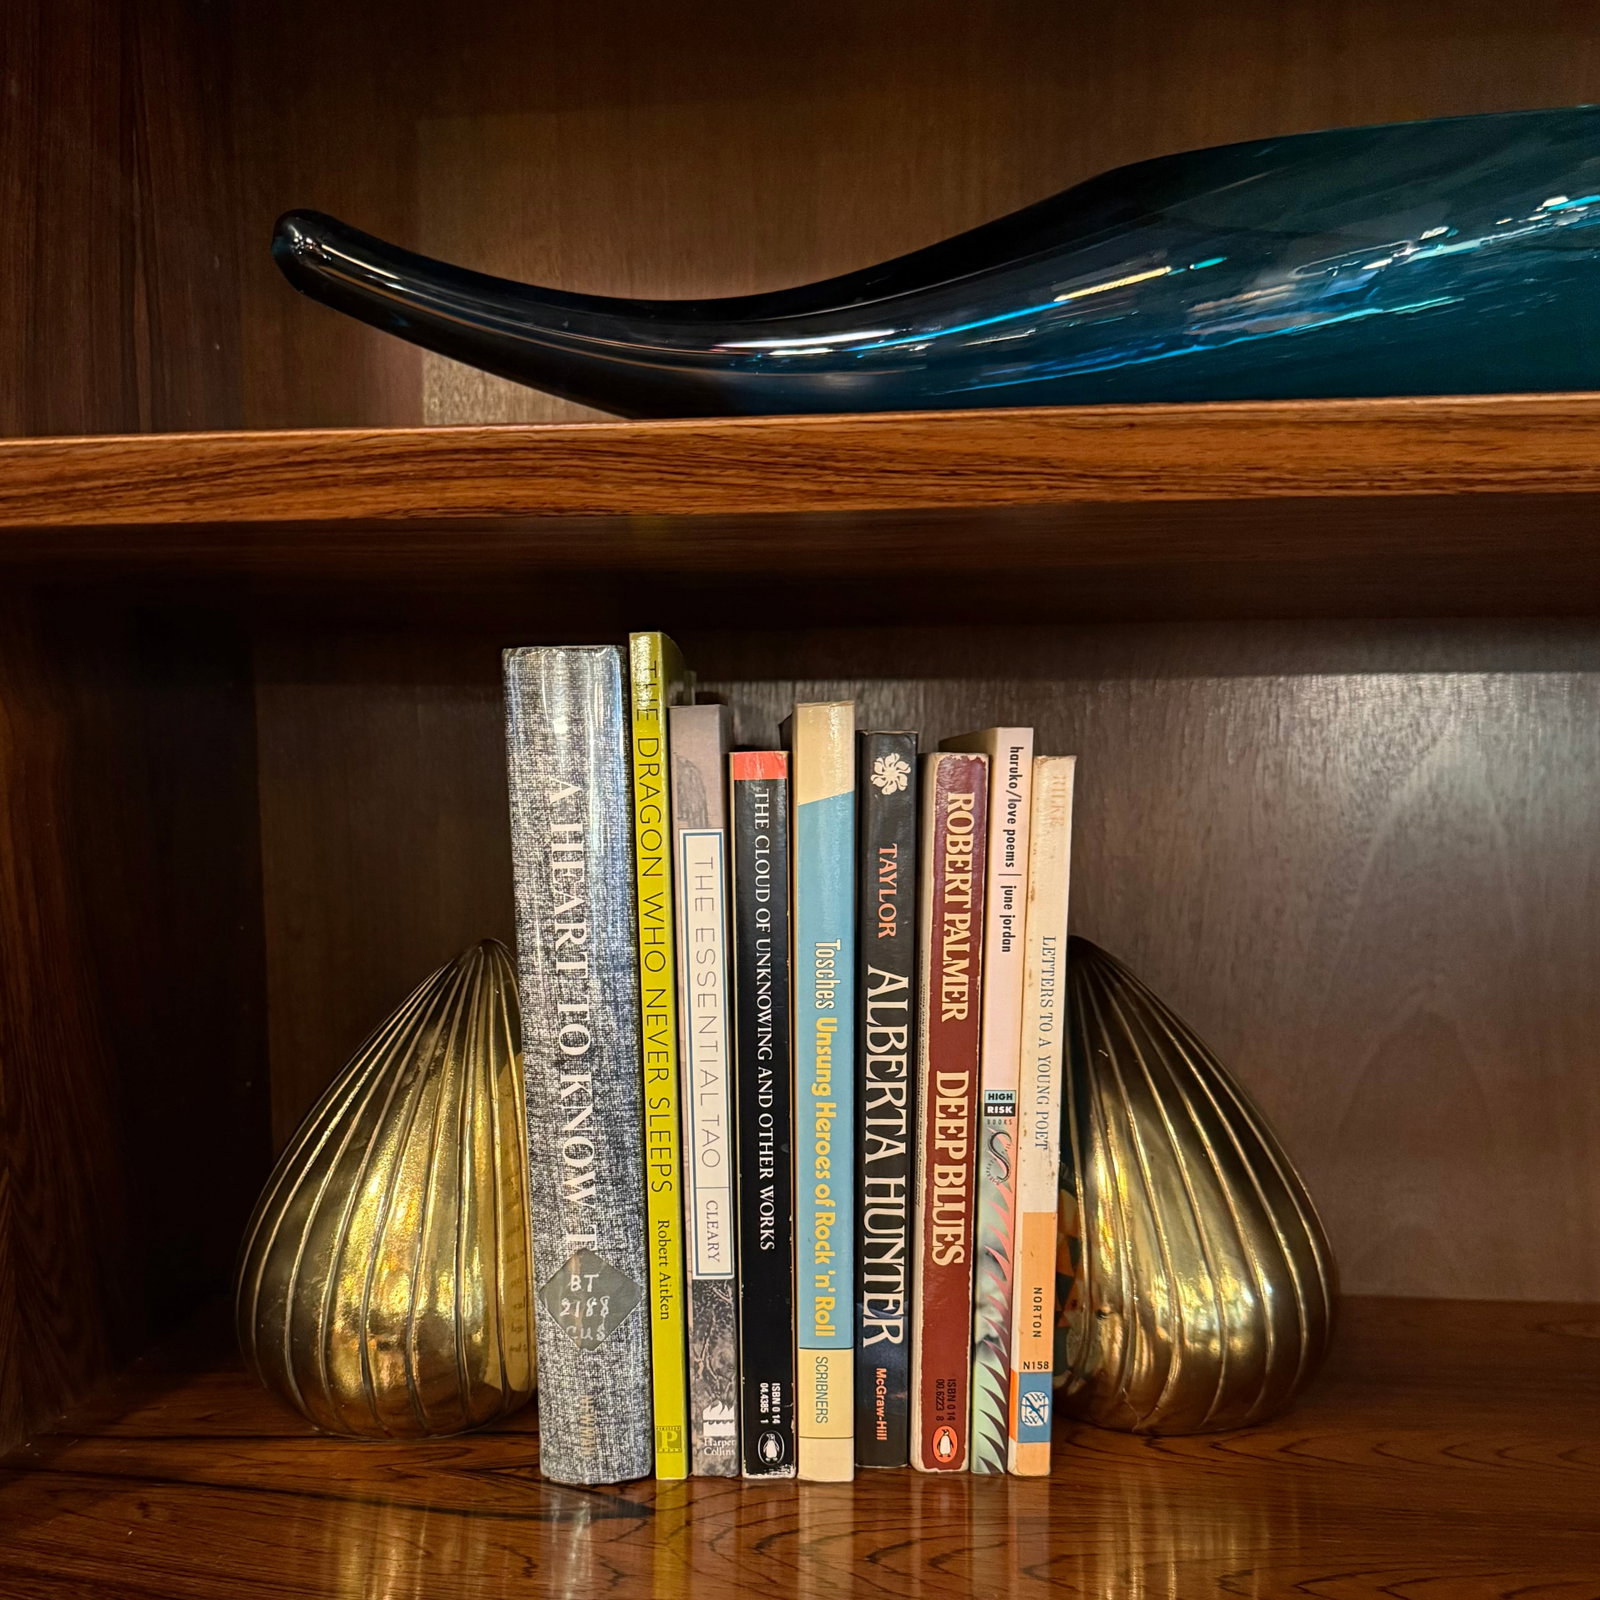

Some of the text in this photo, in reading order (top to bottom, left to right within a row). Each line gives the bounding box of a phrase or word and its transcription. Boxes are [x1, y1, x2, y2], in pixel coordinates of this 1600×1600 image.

[549, 777, 581, 804] A
[1000, 745, 1024, 952] haruko/love poems june jordan
[551, 823, 588, 979] HEART
[878, 843, 897, 938] TAYLOR
[941, 792, 975, 1022] ROBERT PALMER
[636, 661, 673, 1193] THE DRAGON WHO NEVER SLEEPS
[815, 939, 841, 1009] Tosches
[556, 990, 590, 1056] TO
[695, 857, 721, 1167] THE ESSENTIAL TAO
[754, 789, 775, 1250] THE CLOUD OF UNKNOWING AND OTHER WORKS
[1035, 936, 1057, 1150] LETTERS TO A YOUNG POET
[987, 1106, 1013, 1114] RISK
[988, 1093, 1013, 1101] HIGH
[560, 1074, 596, 1209] KNOW
[863, 964, 909, 1347] ALBERTA HUNTER
[931, 1070, 969, 1266] DEEP BLUES
[811, 1017, 837, 1336] Unsung Heroes of Rock 'n' Roll
[705, 1200, 720, 1262] CLEARY
[568, 1274, 600, 1293] BT
[657, 1220, 673, 1320] Robert Aitken
[1033, 1288, 1042, 1338] NORTON
[759, 1383, 768, 1413] 04.4385
[771, 1383, 780, 1404] ISBN
[815, 1356, 828, 1423] SCRIBNERS
[935, 1378, 945, 1410] 00.6223
[947, 1378, 956, 1402] ISBN
[1023, 1361, 1049, 1370] N158
[772, 1415, 781, 1423] 14
[875, 1368, 887, 1440] McGraw-Hill
[946, 1412, 955, 1420] 14
